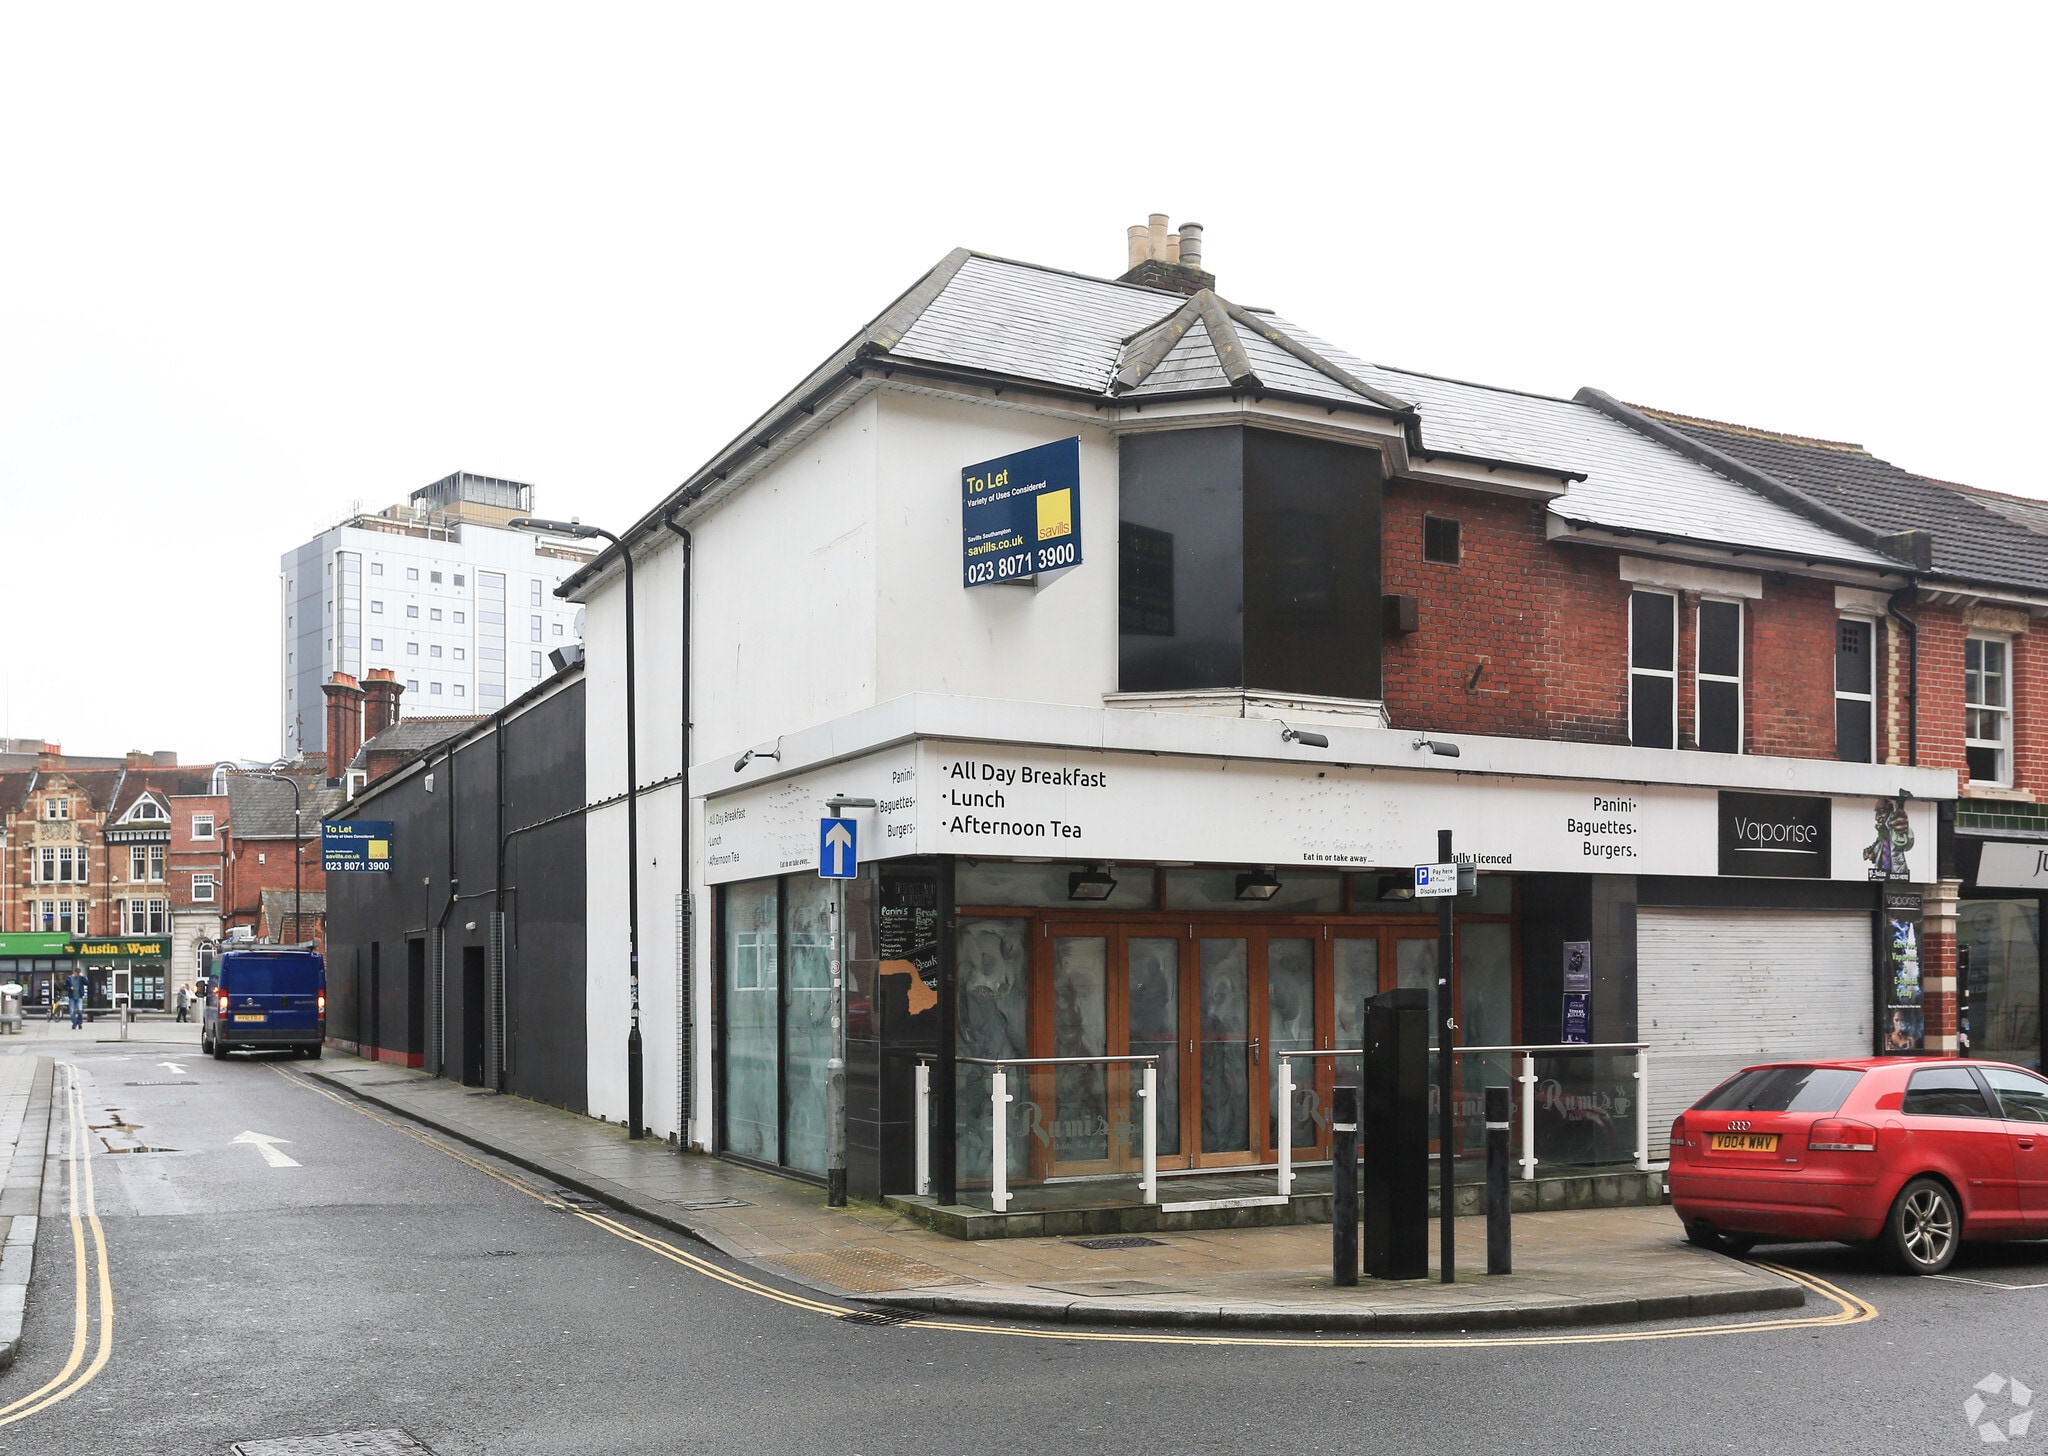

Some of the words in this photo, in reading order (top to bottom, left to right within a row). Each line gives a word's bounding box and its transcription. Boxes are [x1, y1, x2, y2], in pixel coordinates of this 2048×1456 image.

[966, 477, 984, 494] To
[987, 469, 1009, 489] Let
[967, 496, 988, 508] Variety
[988, 494, 995, 502] of
[996, 491, 1010, 500] Uses
[1012, 480, 1046, 496] Considered
[1039, 521, 1070, 539] savills
[968, 534, 1024, 556] savills.co.uk
[968, 560, 994, 584] 023
[998, 552, 1032, 578] 8071
[1038, 542, 1074, 570] 3900
[892, 766, 912, 784] Panini
[950, 761, 976, 780] All
[982, 764, 1016, 786] Day
[1022, 766, 1106, 788] Breakfast
[880, 796, 912, 814] Baguettes
[951, 788, 1005, 808] Lunch
[1594, 797, 1632, 812] Panini
[716, 814, 724, 826] Day
[724, 808, 746, 822] Breakfast
[326, 825, 336, 833] To
[338, 825, 352, 833] Let
[888, 824, 912, 838] Burgers
[950, 815, 1045, 836] Afternoon
[1050, 820, 1082, 838] Tea
[1734, 816, 1817, 848] Vaporise
[709, 834, 722, 846] Lunch
[326, 862, 342, 870] 023
[344, 862, 365, 870] 8071
[368, 862, 390, 870] 3900
[709, 854, 730, 866] Afternoon
[731, 852, 740, 862] Tea
[1303, 852, 1314, 860] Eat
[1316, 852, 1323, 860] in
[1334, 854, 1348, 862] take
[1473, 854, 1512, 864] Licenced
[1432, 868, 1442, 876] Pay
[80, 943, 118, 954] Austin
[126, 943, 160, 956] Wyatt
[1748, 1137, 1772, 1150] WMV
